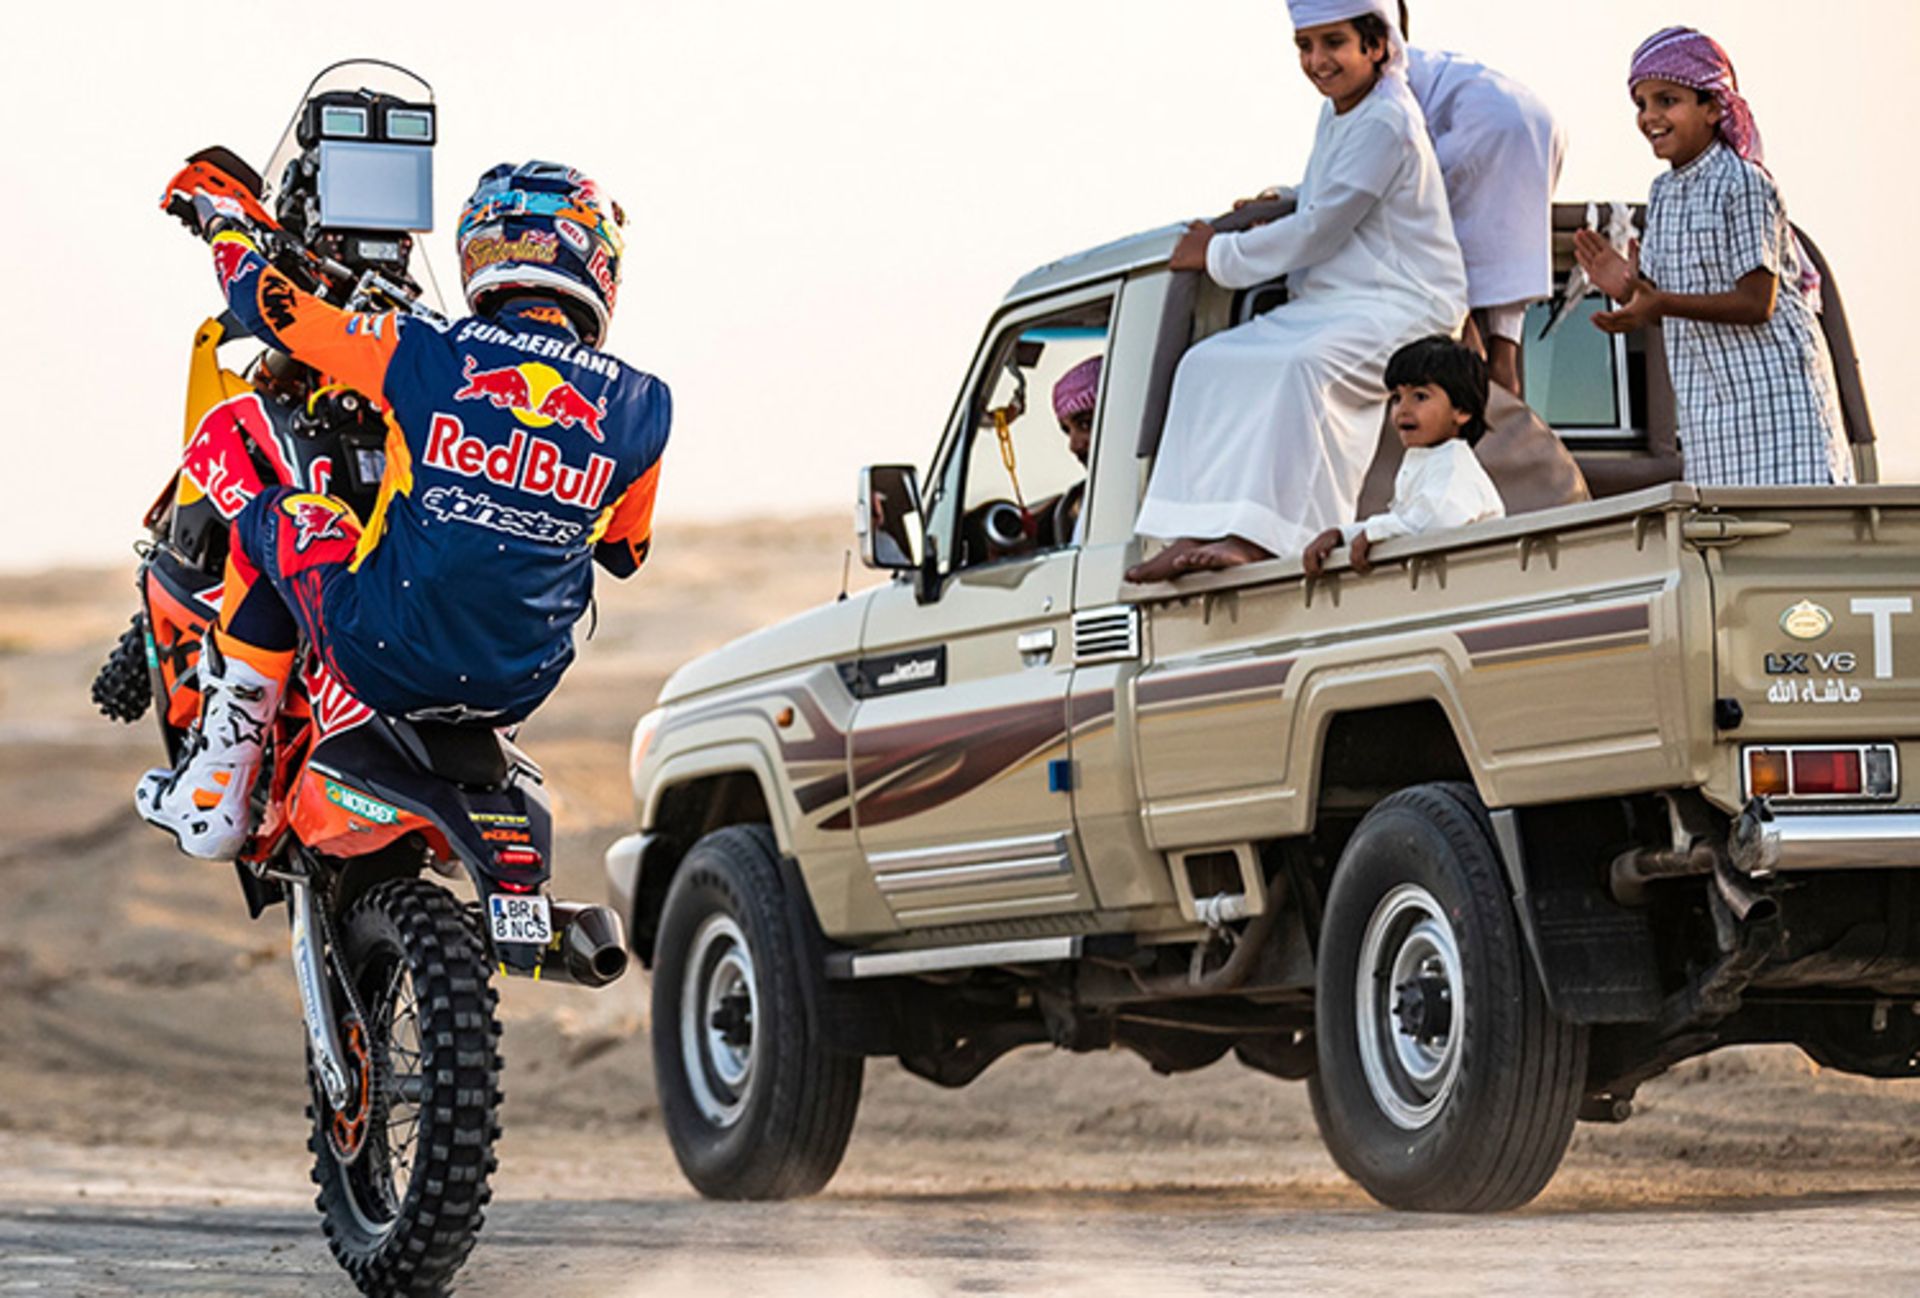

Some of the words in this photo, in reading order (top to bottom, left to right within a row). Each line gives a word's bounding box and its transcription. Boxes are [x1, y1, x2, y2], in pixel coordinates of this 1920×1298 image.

[263, 275, 297, 331] KTM
[457, 321, 620, 380] SUNDERLAND
[422, 411, 528, 488] Red
[519, 437, 617, 509] Bull
[1850, 597, 1912, 678] T
[1765, 653, 1809, 674] LX
[1767, 677, 1799, 703] الله
[507, 900, 531, 917] BR
[495, 920, 507, 938] 8
[511, 920, 549, 939] NCS
